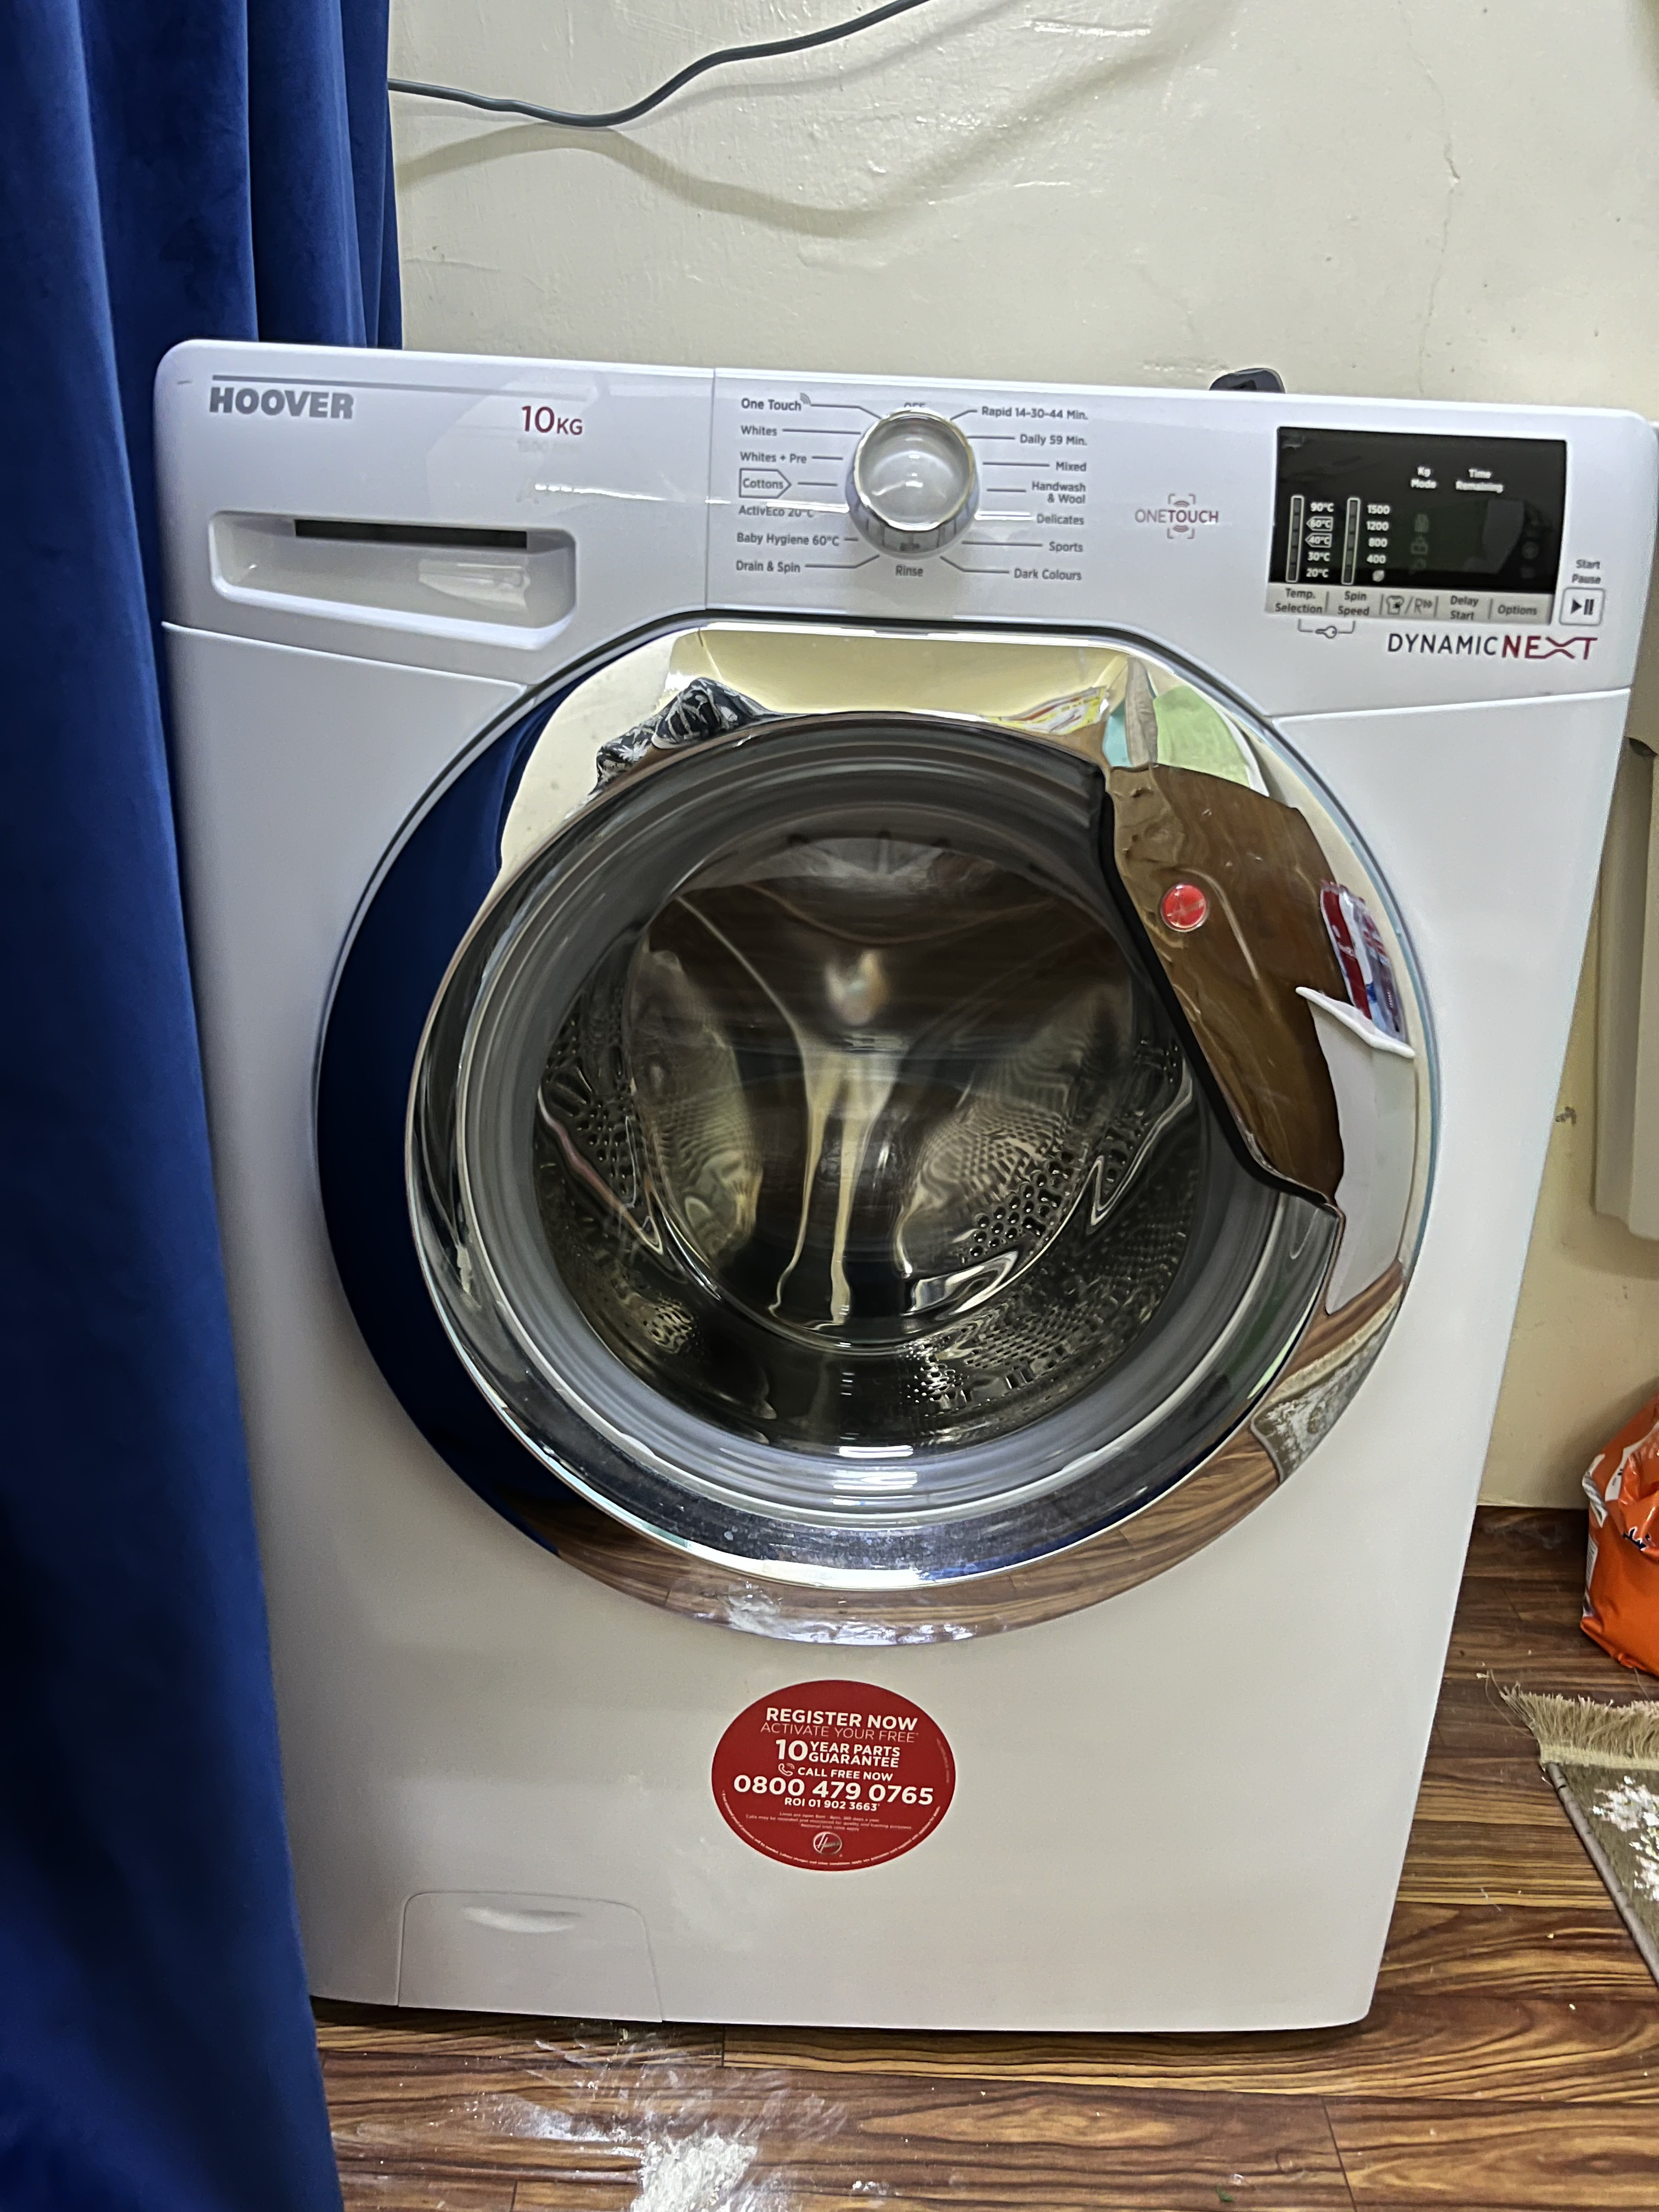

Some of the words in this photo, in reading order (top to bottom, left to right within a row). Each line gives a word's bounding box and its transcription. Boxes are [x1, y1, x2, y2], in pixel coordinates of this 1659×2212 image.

[210, 387, 354, 419] HOOVER
[741, 398, 764, 410] One
[768, 399, 802, 411] Touch
[981, 406, 1012, 417] Rapid
[1015, 408, 1063, 419] 14-30-44
[1066, 410, 1088, 420] Min.
[521, 405, 583, 435] 10KG
[740, 425, 777, 436] Whites
[1020, 434, 1046, 445] Daily
[1049, 435, 1063, 445] 59
[1066, 436, 1088, 446] Min.
[740, 452, 777, 462] Whites
[789, 453, 807, 464] Pre
[1056, 461, 1087, 472] Mixed
[742, 478, 783, 489] Cottons
[1031, 481, 1086, 492] Handwash
[1047, 493, 1054, 503] &
[1058, 494, 1086, 504] Wool
[738, 505, 785, 517] ActivEco
[1310, 502, 1334, 512] 90°C
[1367, 504, 1391, 515] 1500
[1036, 514, 1085, 525] Delicates
[1135, 509, 1219, 523] ONETOUCH
[1366, 521, 1389, 531] 1200
[737, 532, 763, 545] Baby
[766, 533, 809, 546] Hygiene
[812, 535, 839, 546] 60°C
[1048, 541, 1084, 552] Sports
[1307, 551, 1330, 562] 30°C
[1366, 554, 1386, 564] 400
[736, 560, 764, 571] Drain
[766, 561, 774, 572] &
[777, 562, 800, 574] Spin
[1576, 559, 1600, 569] Start
[895, 565, 923, 577] Rinse
[1014, 568, 1039, 579] Dark
[1042, 569, 1082, 580] Colours
[1306, 568, 1329, 578] 20°C
[1572, 573, 1601, 584] Pause
[1285, 588, 1316, 600] Temp.
[1344, 591, 1367, 601] Spin
[1450, 595, 1479, 607] Delay
[1275, 602, 1323, 614] Selection
[1337, 606, 1370, 616] Speed
[1497, 604, 1537, 616] Options
[1450, 610, 1475, 620] Start
[766, 1707, 862, 1727] REGISTER
[867, 1714, 918, 1730] NOW
[760, 1722, 829, 1737] ACTIVATE
[834, 1728, 874, 1740] YOUR
[776, 1739, 808, 1761] 10
[810, 1741, 849, 1754] YEAR
[854, 1744, 900, 1757] PARTS
[809, 1752, 899, 1768] GUARANTEE
[798, 1767, 827, 1778] CALL
[831, 1769, 860, 1779] FREE
[863, 1771, 893, 1781] NOW
[733, 1774, 805, 1796] 0800
[812, 1780, 861, 1800] 479
[868, 1784, 933, 1805] 0765
[785, 1797, 805, 1807] ROI
[808, 1798, 821, 1808] 01
[824, 1799, 846, 1810] 902
